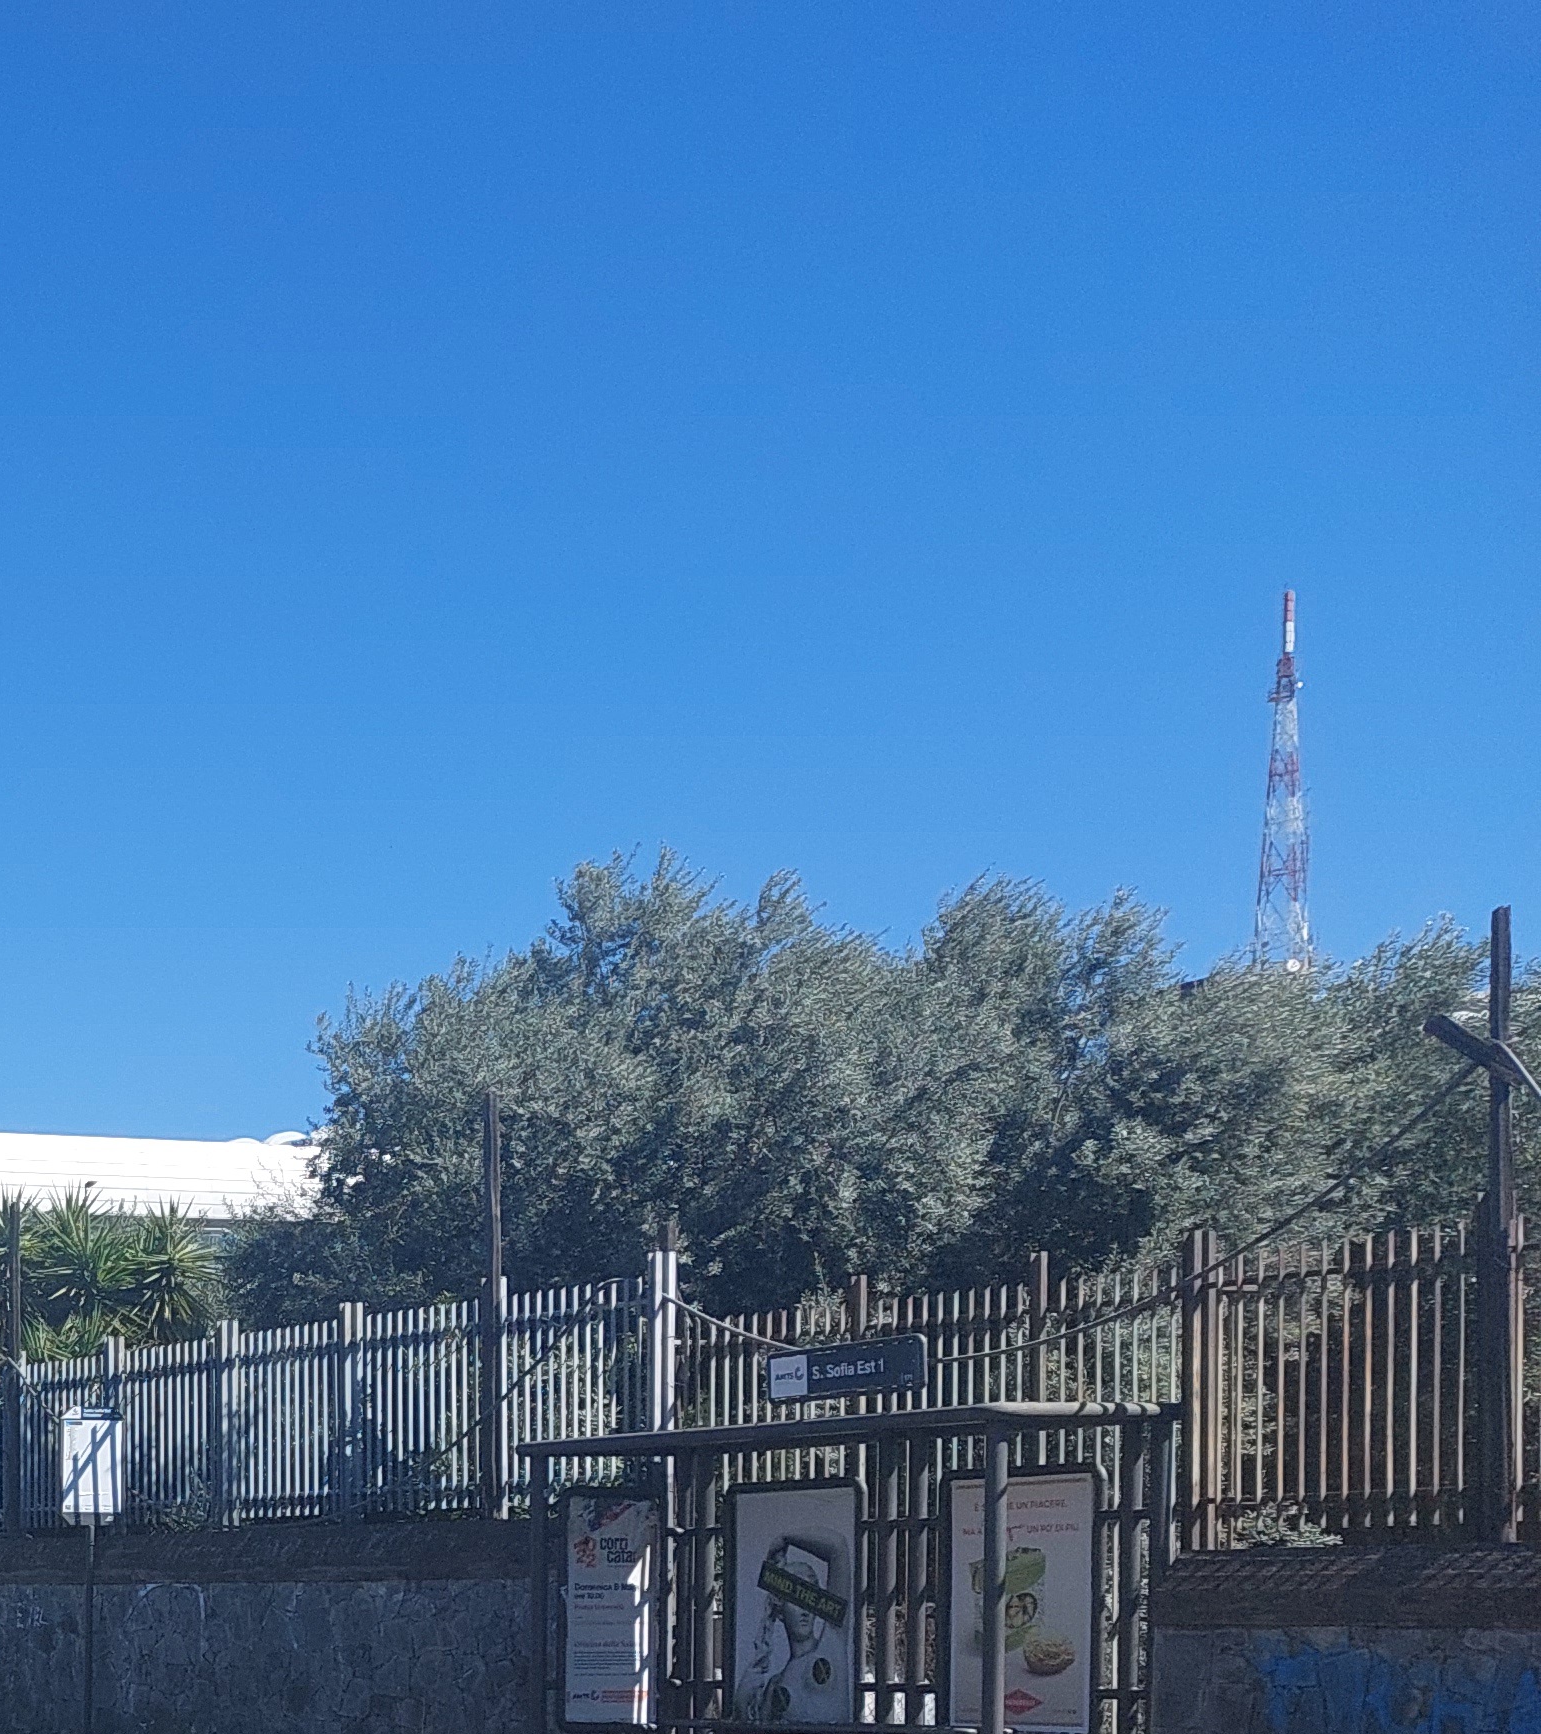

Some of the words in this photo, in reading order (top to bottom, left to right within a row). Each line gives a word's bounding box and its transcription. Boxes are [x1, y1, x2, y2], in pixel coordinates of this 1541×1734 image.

[811, 1366, 823, 1380] S.
[826, 1363, 855, 1378] Sofia
[857, 1360, 876, 1374] Est
[763, 1571, 793, 1593] MIND
[795, 1584, 819, 1606] THE
[817, 1597, 843, 1619] ART
